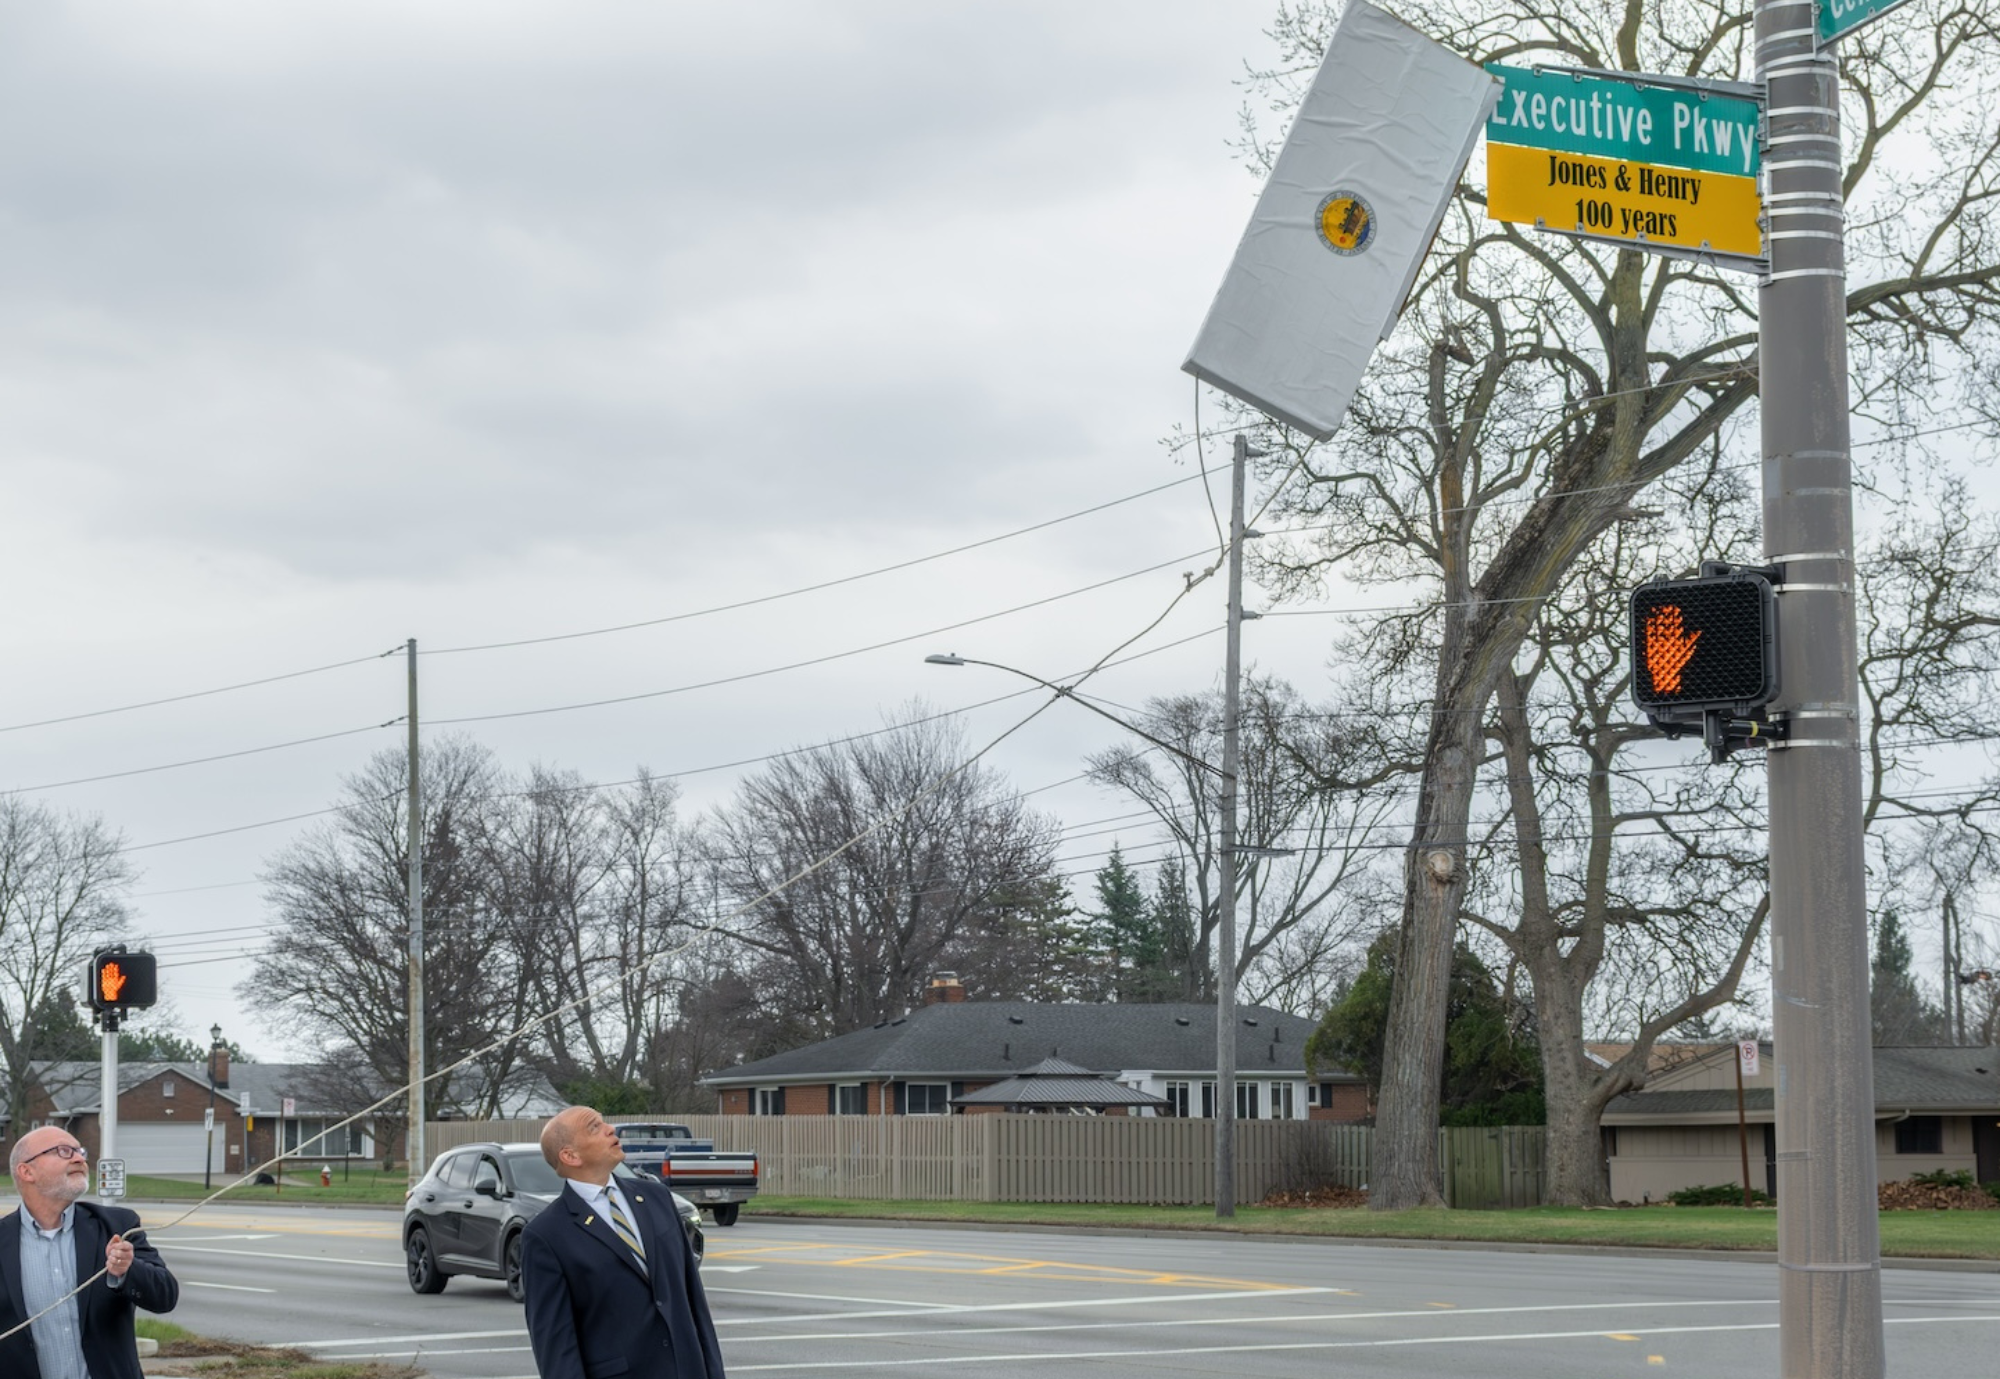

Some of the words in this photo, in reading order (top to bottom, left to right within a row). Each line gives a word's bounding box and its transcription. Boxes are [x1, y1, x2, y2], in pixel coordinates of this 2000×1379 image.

[1673, 101, 1755, 173] Pkwy
[1548, 155, 1607, 189] Jones
[1614, 165, 1632, 192] &
[1639, 167, 1702, 205] Henry
[1575, 198, 1613, 229] 100
[1620, 207, 1677, 237] years
